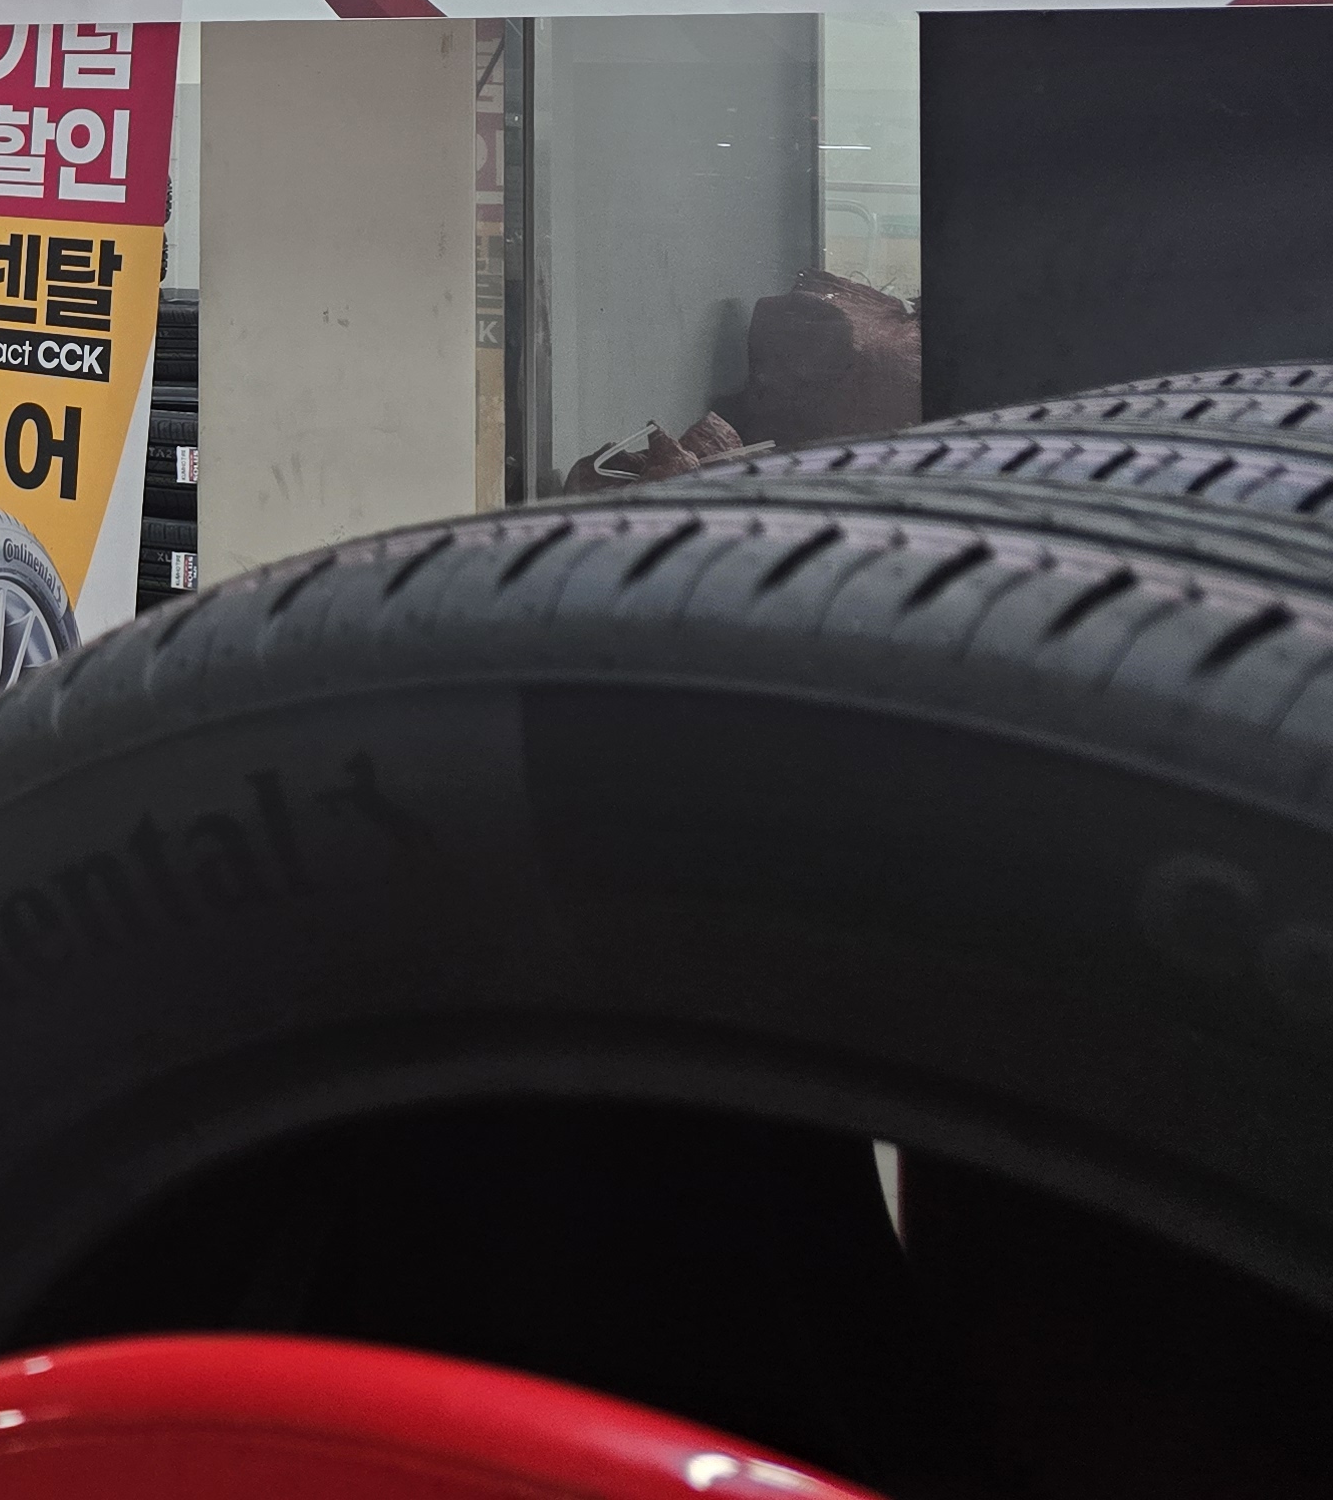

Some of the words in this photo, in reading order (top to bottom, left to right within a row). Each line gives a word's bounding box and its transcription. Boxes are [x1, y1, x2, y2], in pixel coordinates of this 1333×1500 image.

[37, 340, 104, 375] CCK
[148, 447, 173, 458] TA2
[3, 537, 58, 595] Continental
